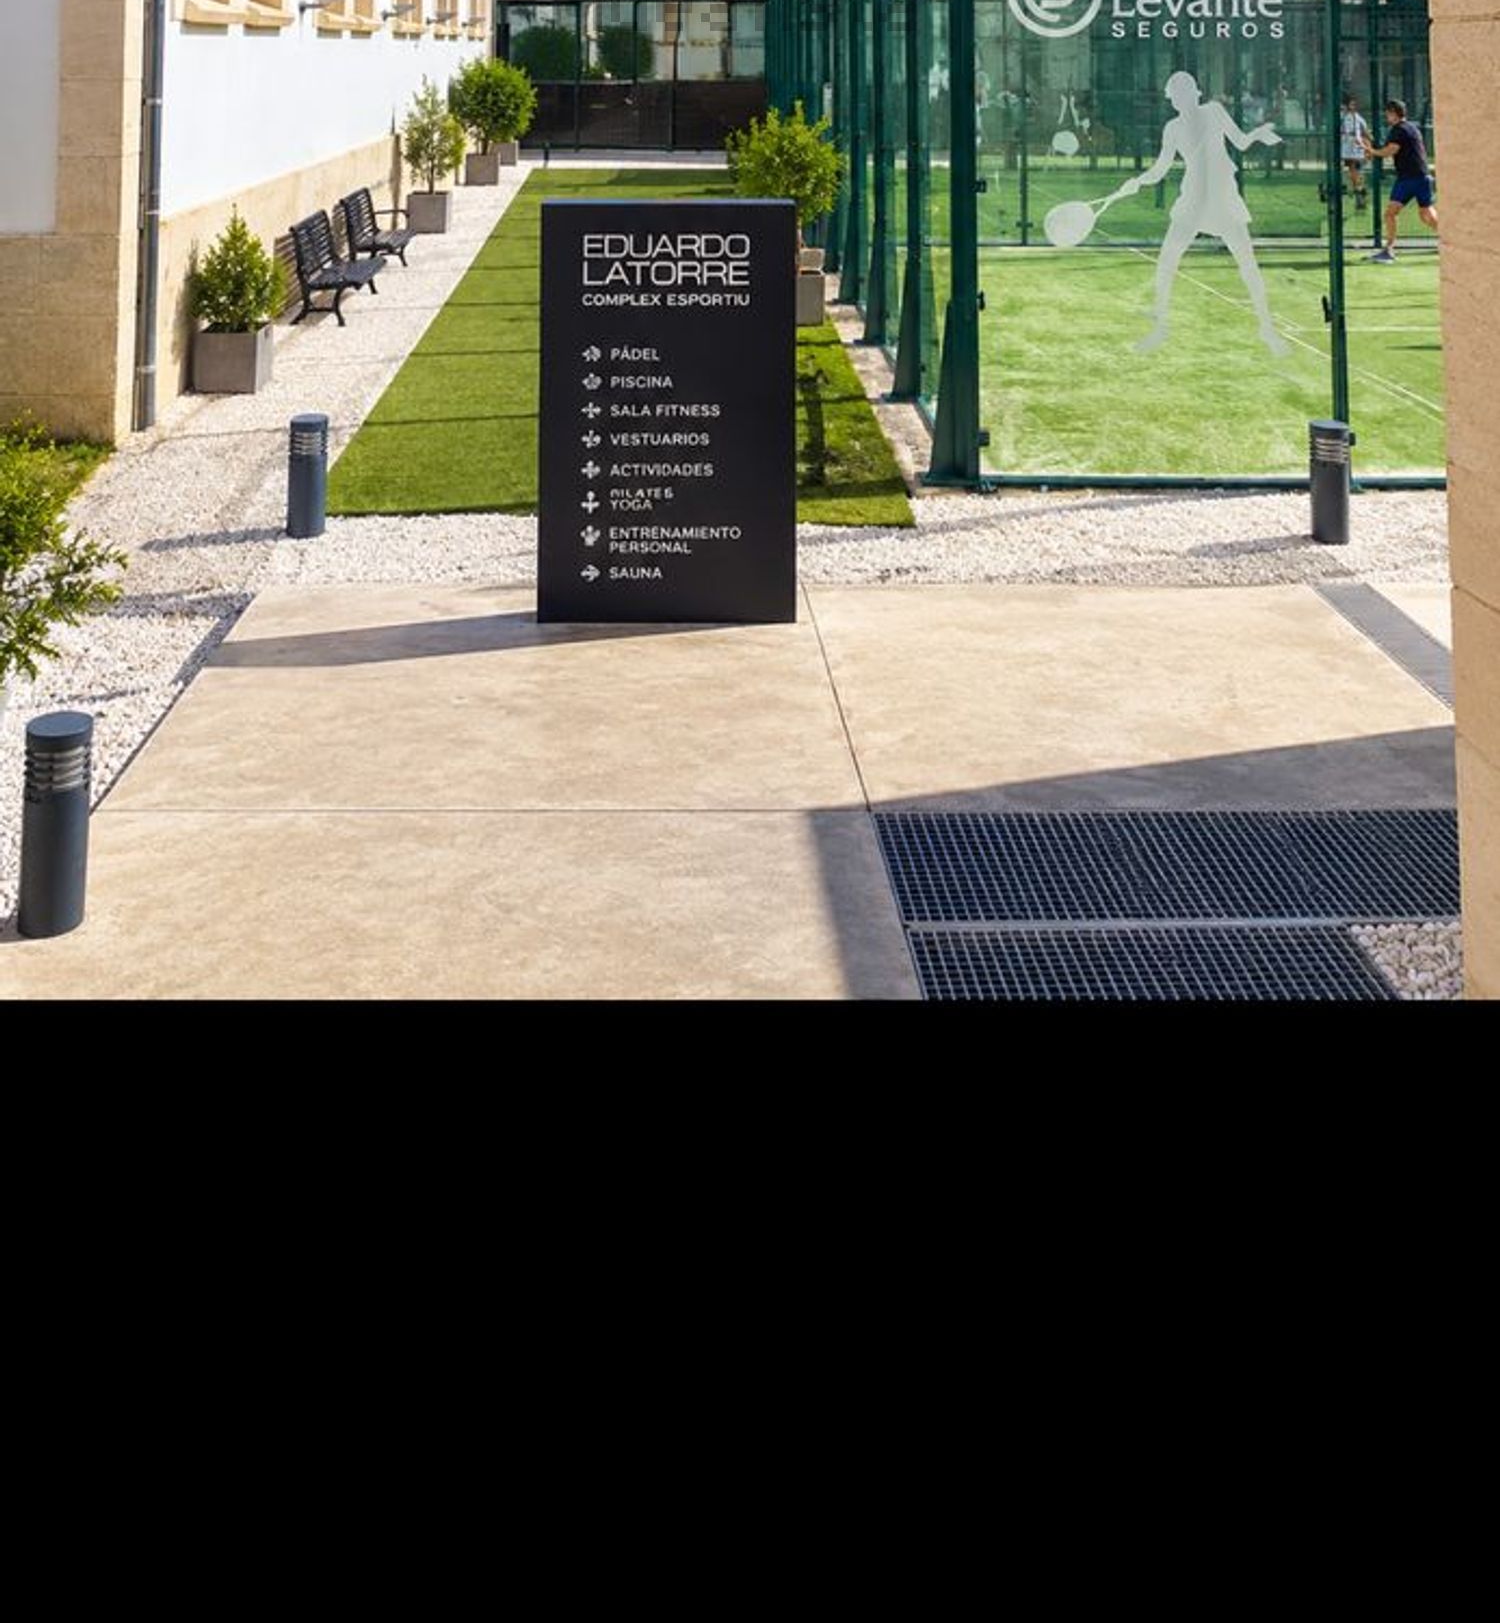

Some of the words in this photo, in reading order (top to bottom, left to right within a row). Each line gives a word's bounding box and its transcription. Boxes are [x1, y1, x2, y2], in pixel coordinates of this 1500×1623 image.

[1111, 22, 1285, 39] SEGUROS
[583, 233, 751, 259] EDUARDO
[582, 260, 750, 286] LATORRE
[582, 293, 662, 307] COMPLEX
[666, 293, 750, 307] ESPORTIU
[610, 375, 673, 389] PISCINA
[610, 404, 652, 417] SALA
[655, 404, 721, 417] FITNESS
[610, 432, 710, 447] VESTUARIOS
[610, 463, 714, 477] ACTIVIDADES
[610, 498, 653, 511] YOGA
[609, 525, 742, 540] ENTRENAMIENTO
[609, 540, 692, 554] PERSONAL
[609, 566, 663, 579] SAUNA
